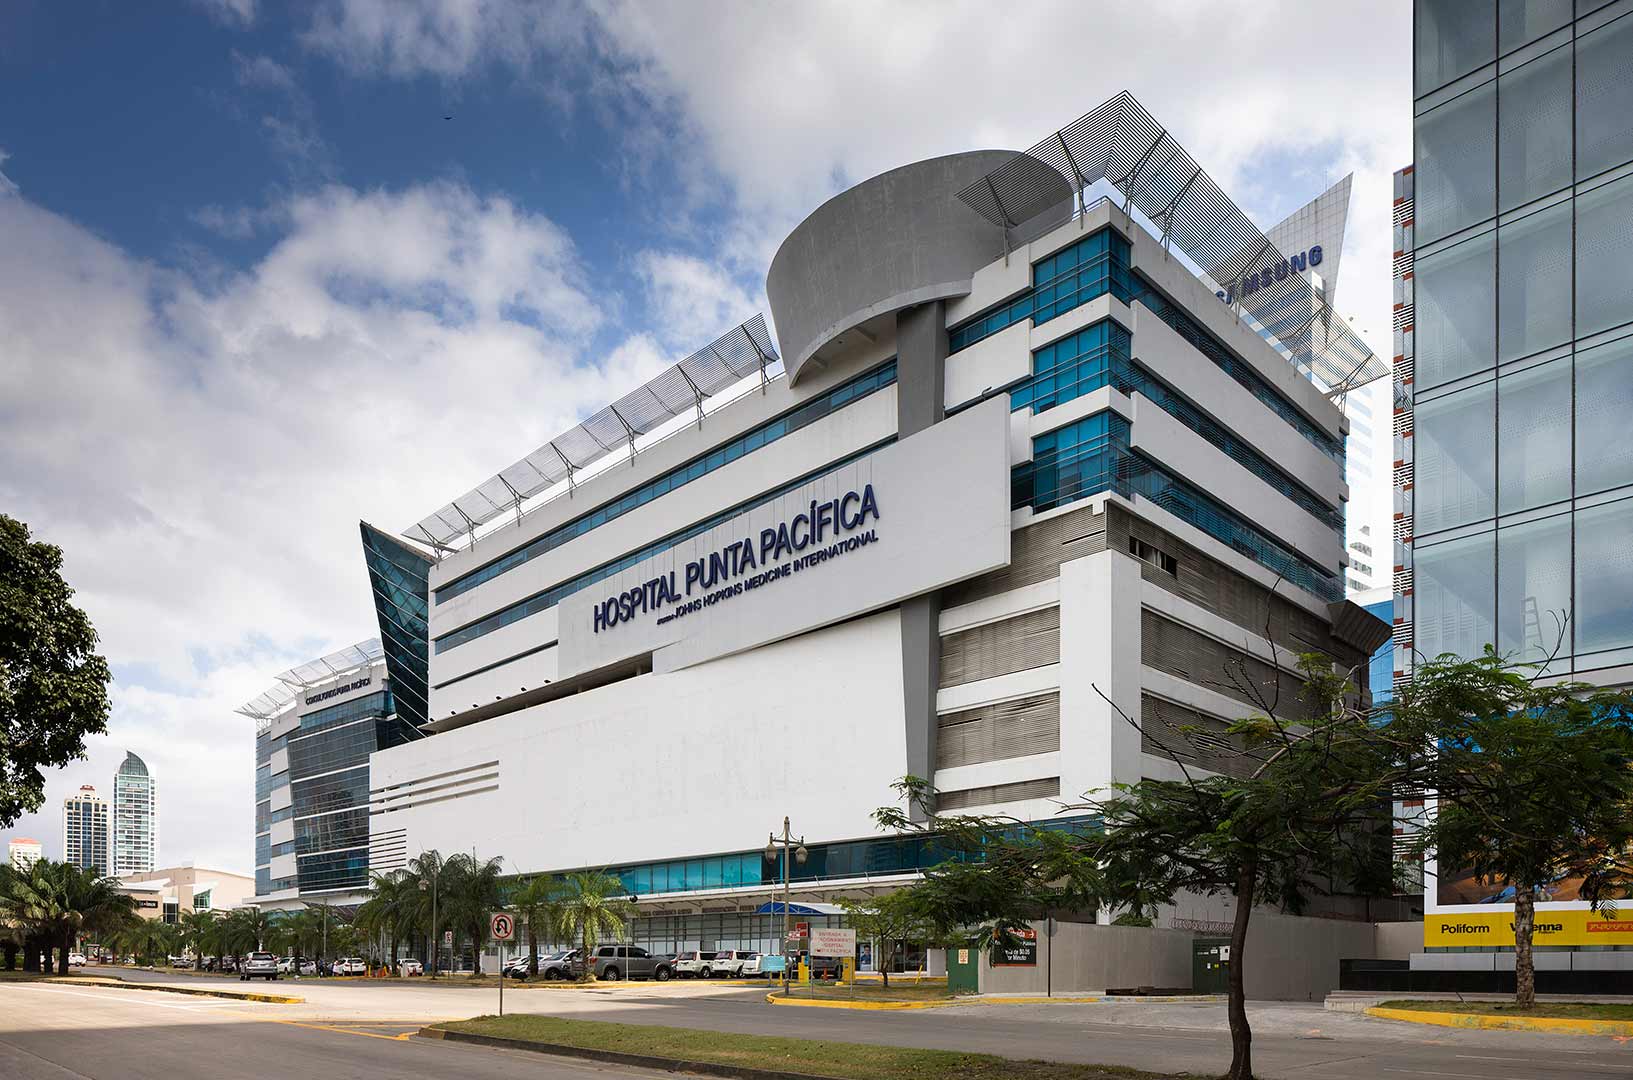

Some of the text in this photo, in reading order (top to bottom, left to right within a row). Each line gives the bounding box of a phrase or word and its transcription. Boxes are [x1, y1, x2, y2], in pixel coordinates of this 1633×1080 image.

[594, 484, 880, 633] HOSPITAL PUNTA PACÍFICA
[674, 529, 879, 618] JOHNS HOPKINS MEDICINE INTERNATIONAL
[1441, 924, 1490, 934] Poliform
